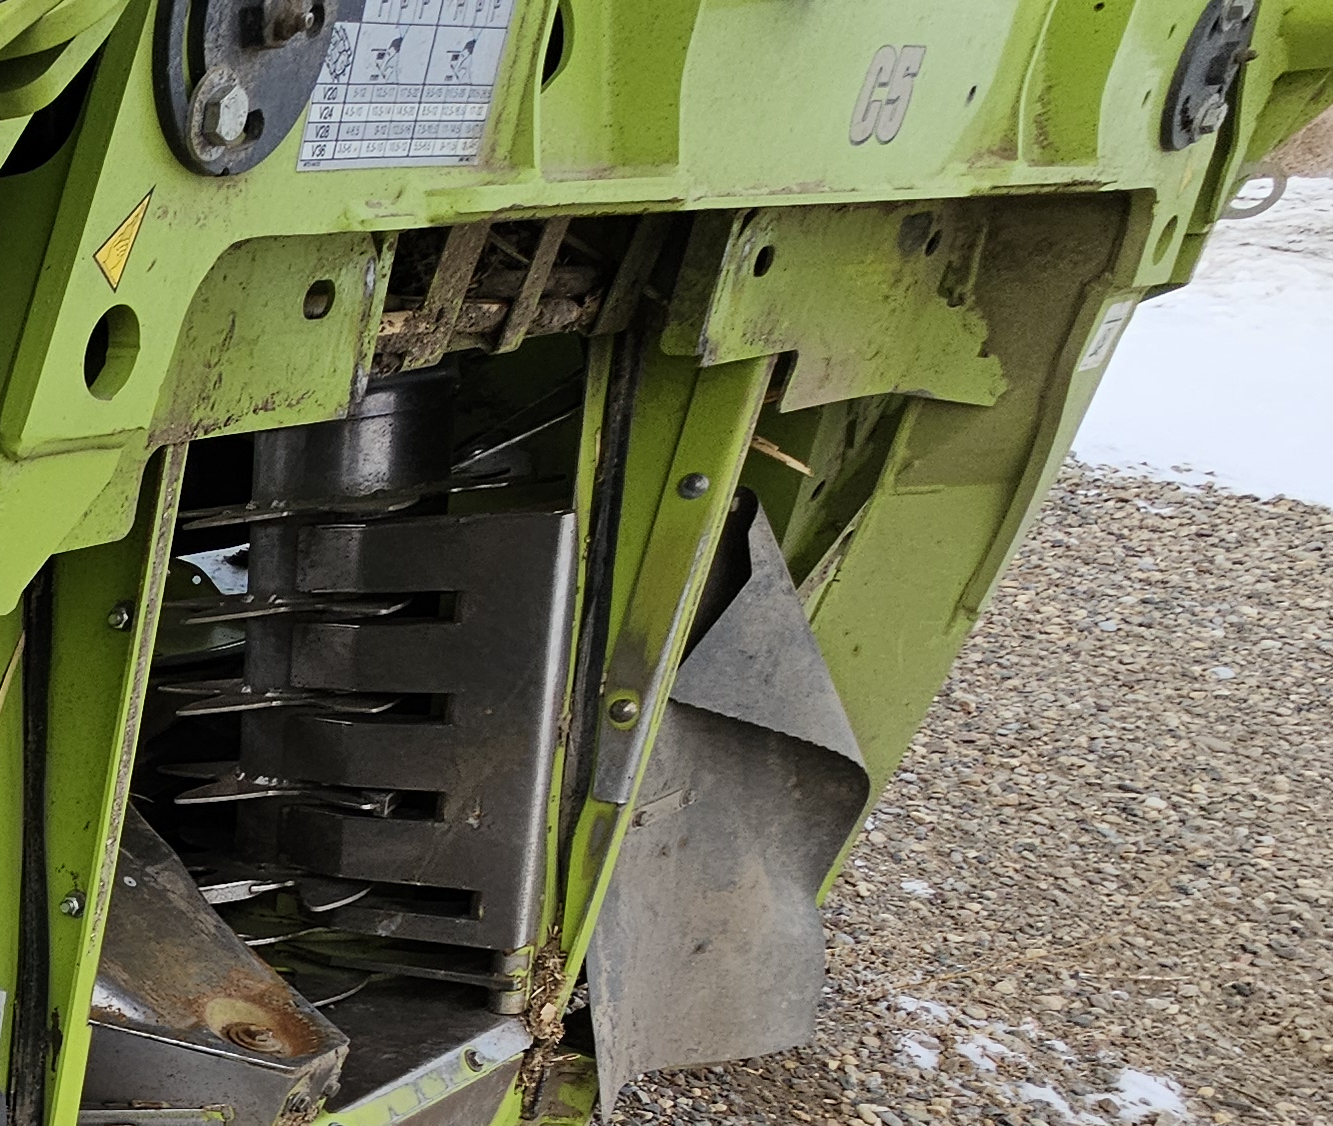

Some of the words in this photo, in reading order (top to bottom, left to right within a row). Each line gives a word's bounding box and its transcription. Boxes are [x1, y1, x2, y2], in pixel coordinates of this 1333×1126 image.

[323, 87, 338, 101] V20
[848, 44, 927, 147] C5
[319, 106, 334, 120] V24
[315, 125, 330, 139] V28
[311, 144, 327, 157] V36
